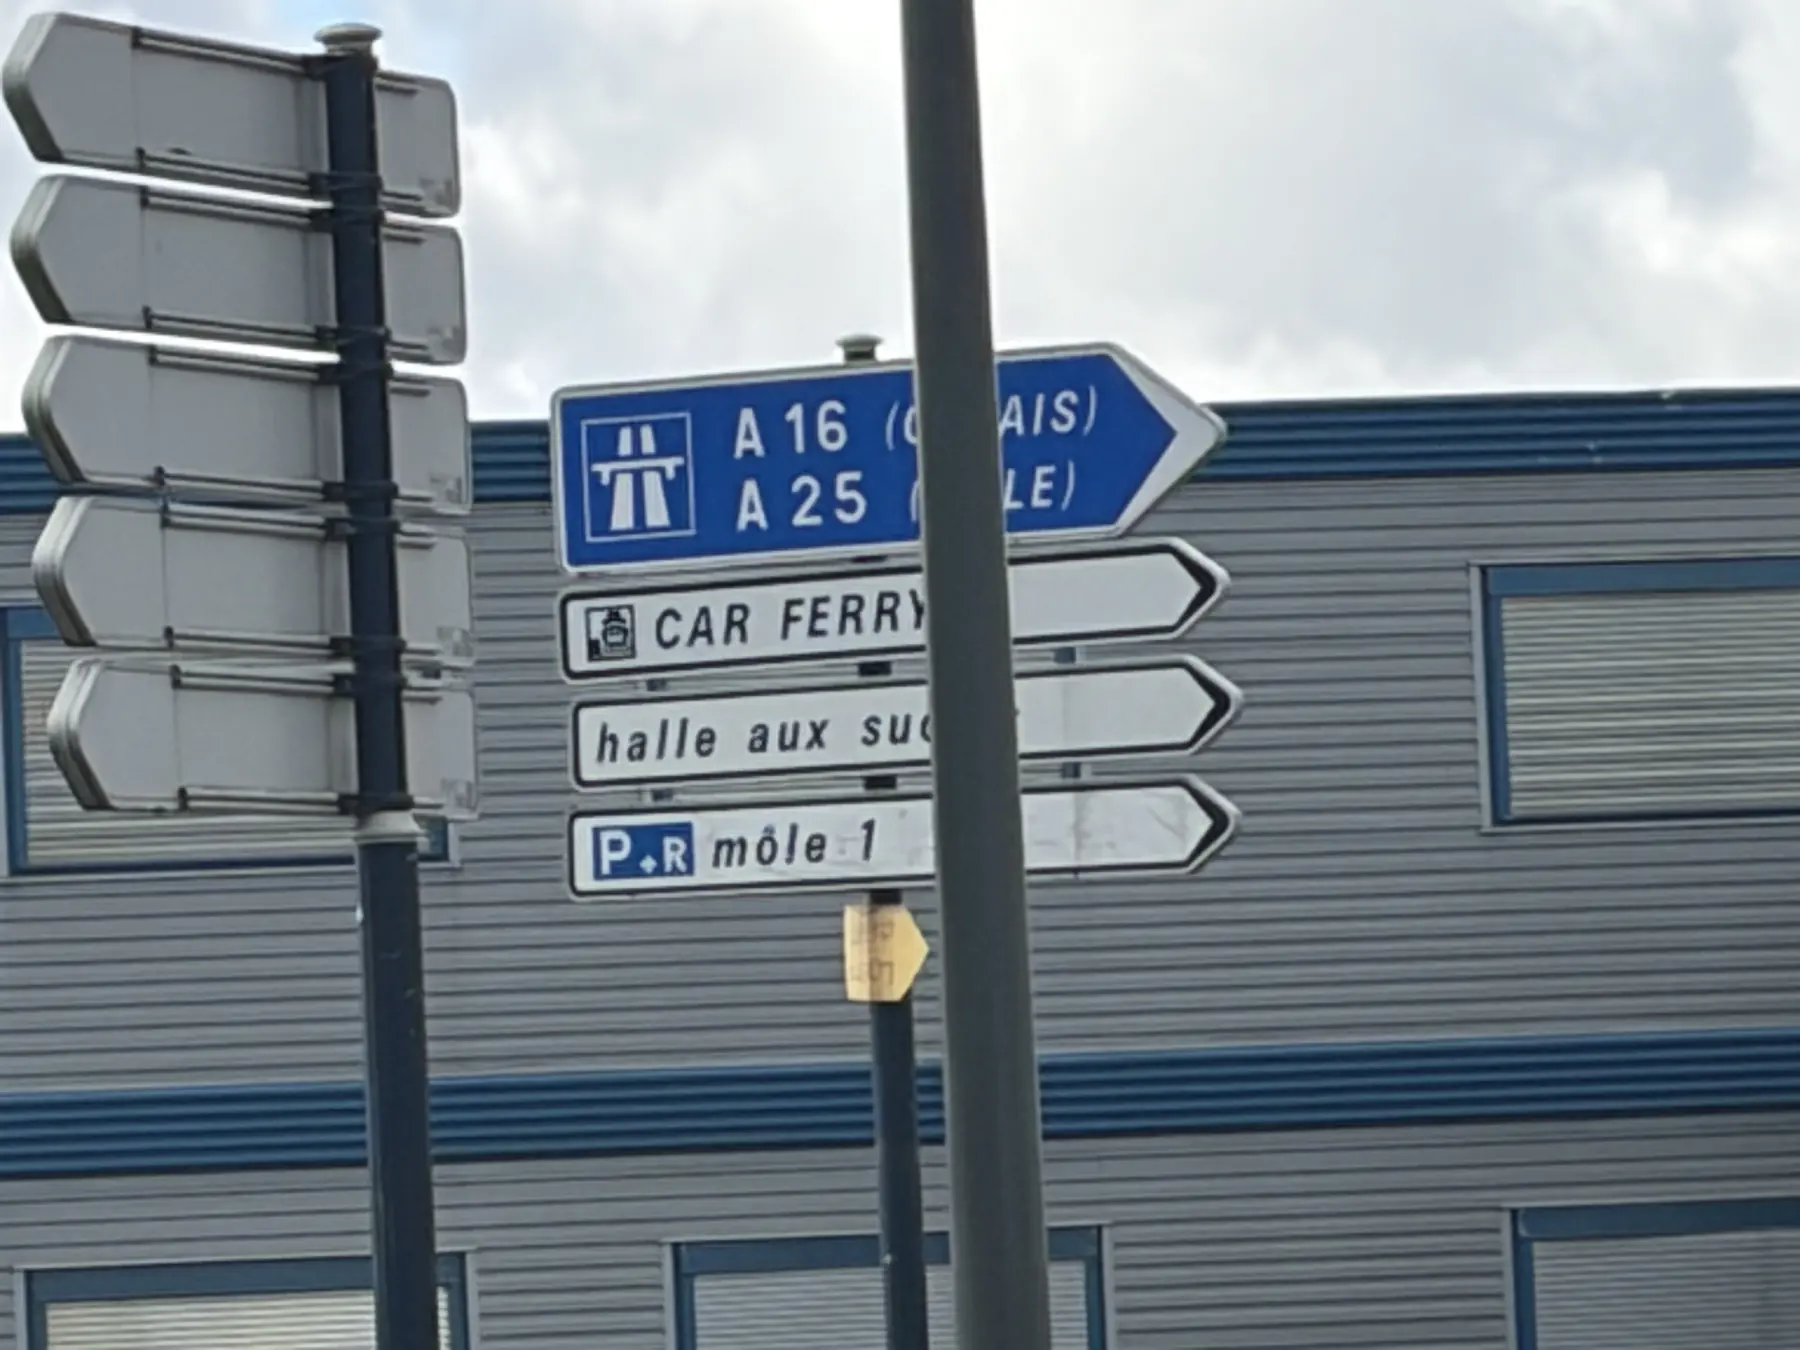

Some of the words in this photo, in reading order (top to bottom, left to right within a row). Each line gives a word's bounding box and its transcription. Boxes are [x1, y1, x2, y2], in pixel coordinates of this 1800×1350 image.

[733, 407, 766, 460] A
[784, 399, 848, 454] 16
[736, 479, 769, 532] A
[791, 470, 868, 527] 25
[655, 602, 751, 650] CAR
[780, 588, 926, 641] FERRY
[596, 716, 718, 764] halle
[748, 718, 831, 754] aux
[712, 821, 828, 869] môle
[860, 817, 877, 863] 1
